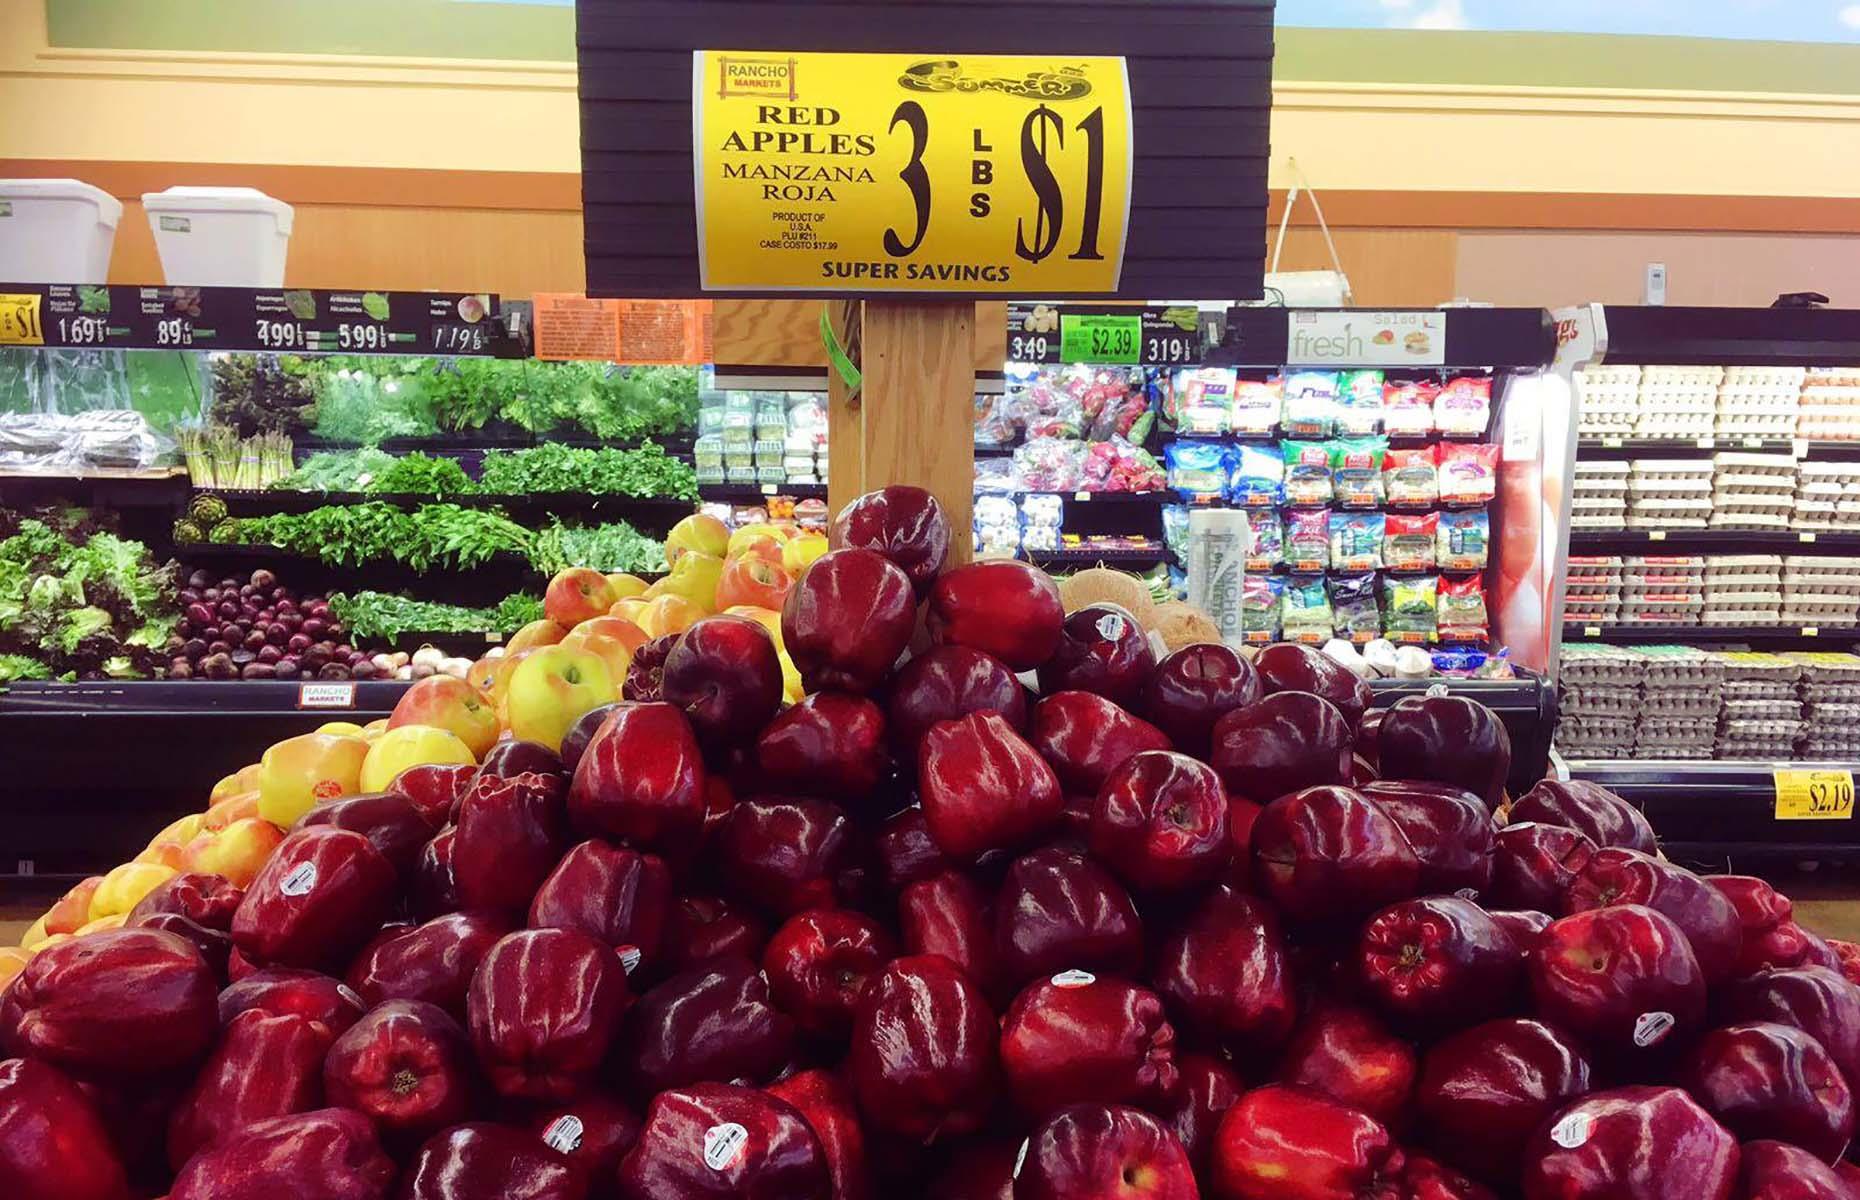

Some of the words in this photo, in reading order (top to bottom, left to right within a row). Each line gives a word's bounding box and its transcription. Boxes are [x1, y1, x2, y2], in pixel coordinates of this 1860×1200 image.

[728, 65, 788, 78] RANCHO
[734, 79, 782, 88] MARKETS
[756, 105, 841, 126] RED
[721, 130, 876, 156] APPLES
[721, 162, 877, 183] MANZANA
[883, 100, 931, 258] 3
[1015, 103, 1105, 264] $1
[762, 184, 838, 202] ROJA
[772, 212, 812, 222] PRODUCT
[814, 213, 826, 222] OF
[760, 240, 782, 249] CASE
[783, 240, 812, 250] COSTO
[813, 241, 838, 250] $17.99
[781, 231, 798, 240] PLU
[822, 259, 899, 280] SUPER
[906, 263, 1011, 282] SAVINGS
[59, 317, 95, 343] 1.69
[1374, 312, 1417, 325] Salad
[339, 324, 378, 349] 5.99
[435, 327, 471, 350] 1.19
[1011, 336, 1047, 360] 3.49
[1091, 328, 1132, 355] $2.39
[1293, 322, 1363, 358] fresh
[1148, 338, 1182, 361] 3.19
[1808, 783, 1851, 812] $2.19
